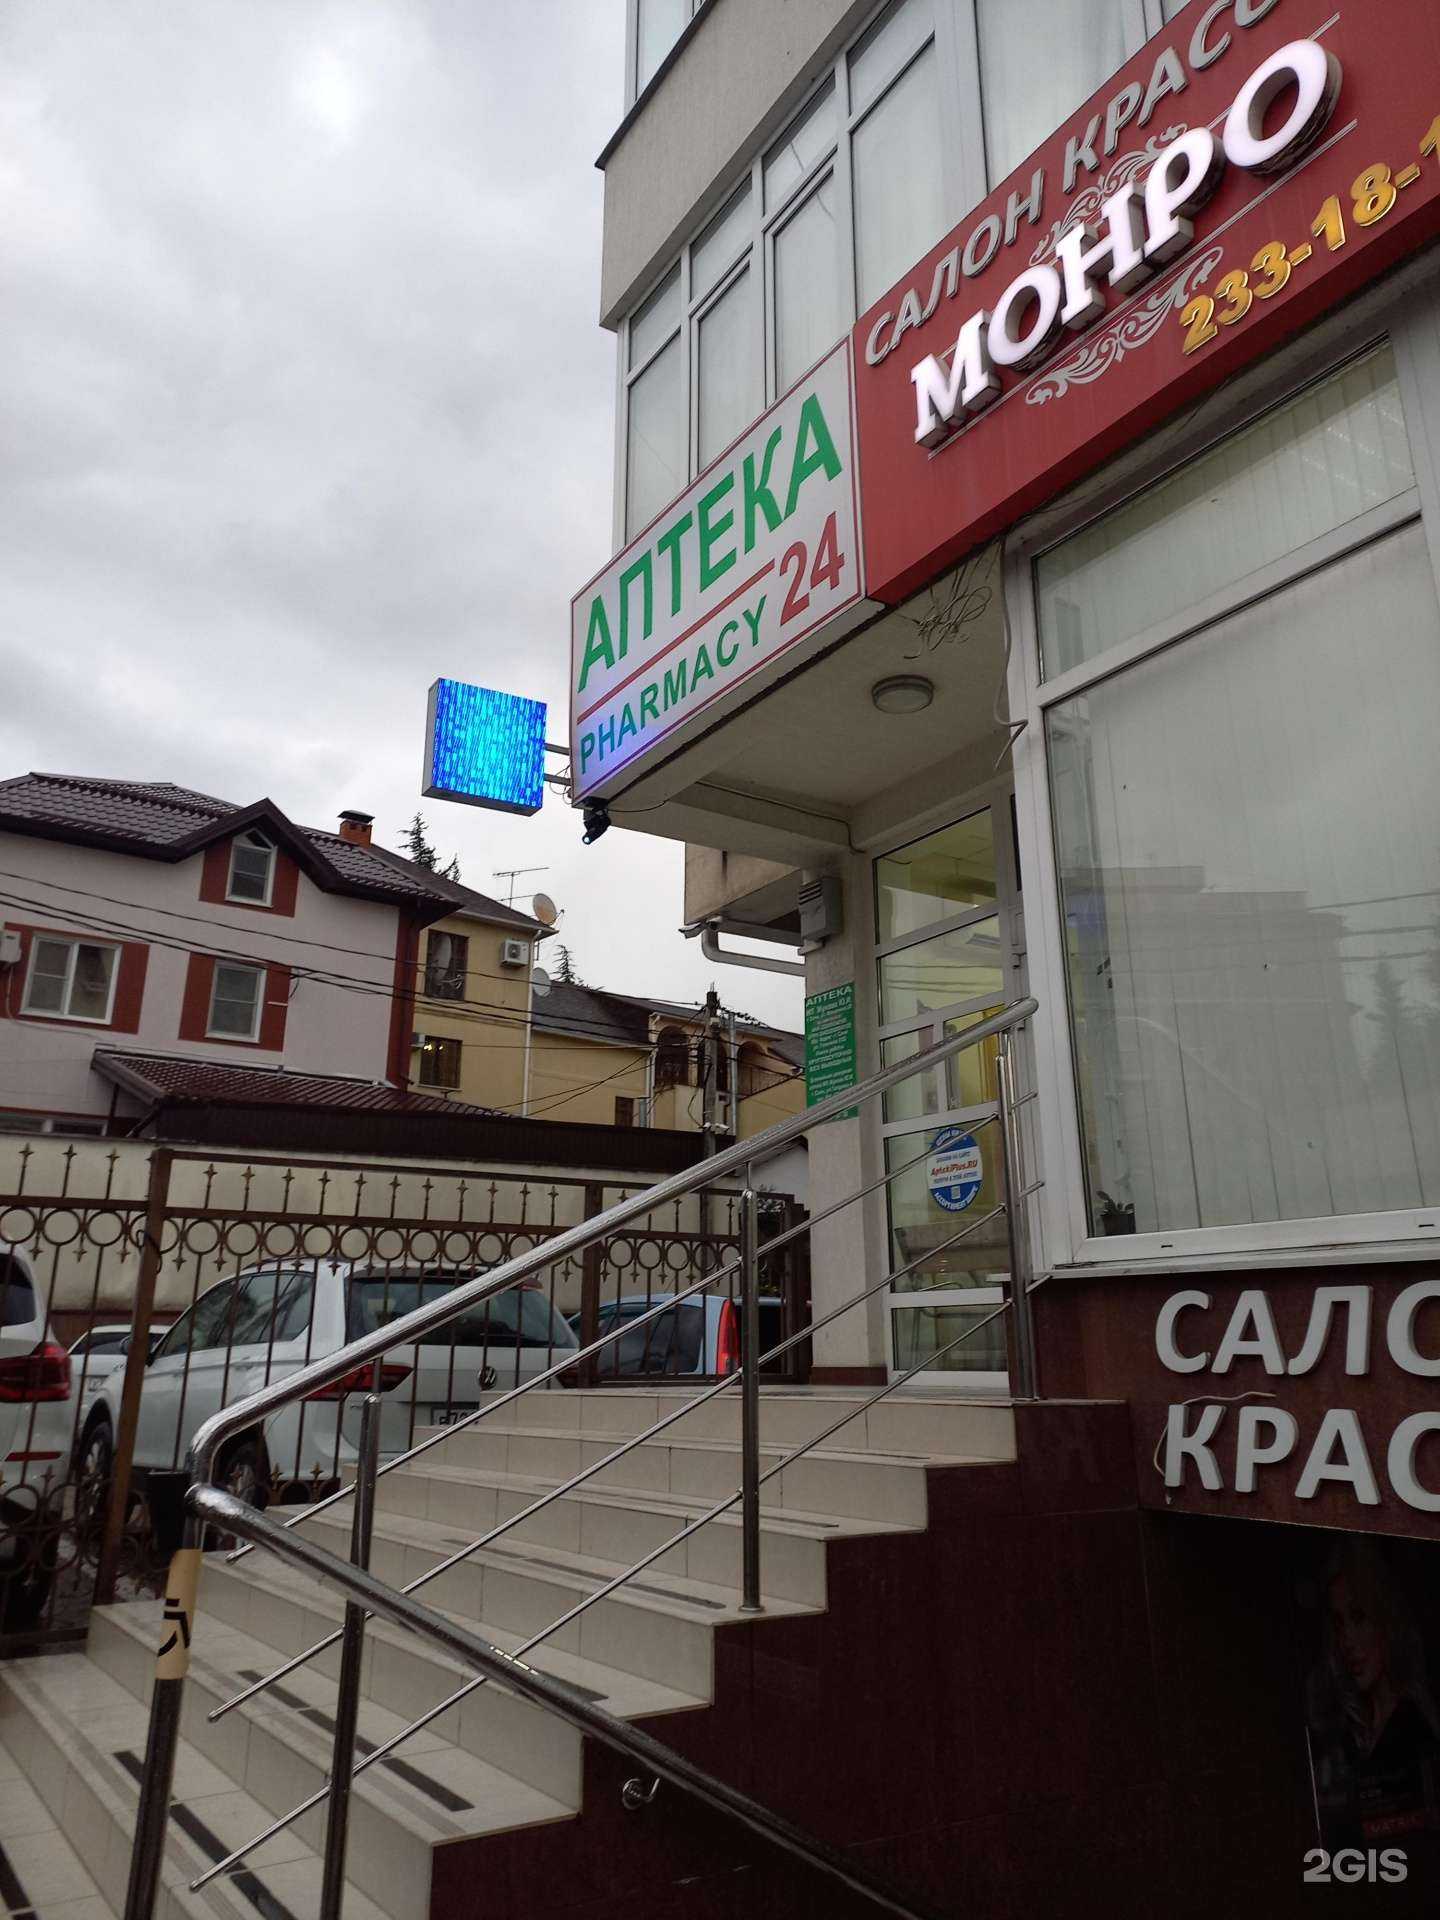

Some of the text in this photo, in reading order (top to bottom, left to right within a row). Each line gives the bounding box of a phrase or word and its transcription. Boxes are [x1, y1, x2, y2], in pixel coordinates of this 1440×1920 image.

[866, 168, 1044, 366] САЛОН
[911, 39, 1342, 447] МОНРО
[577, 393, 843, 693] АПТЕКА
[579, 511, 845, 775] PHARMACY 24
[806, 985, 853, 1007] АПТЕКА
